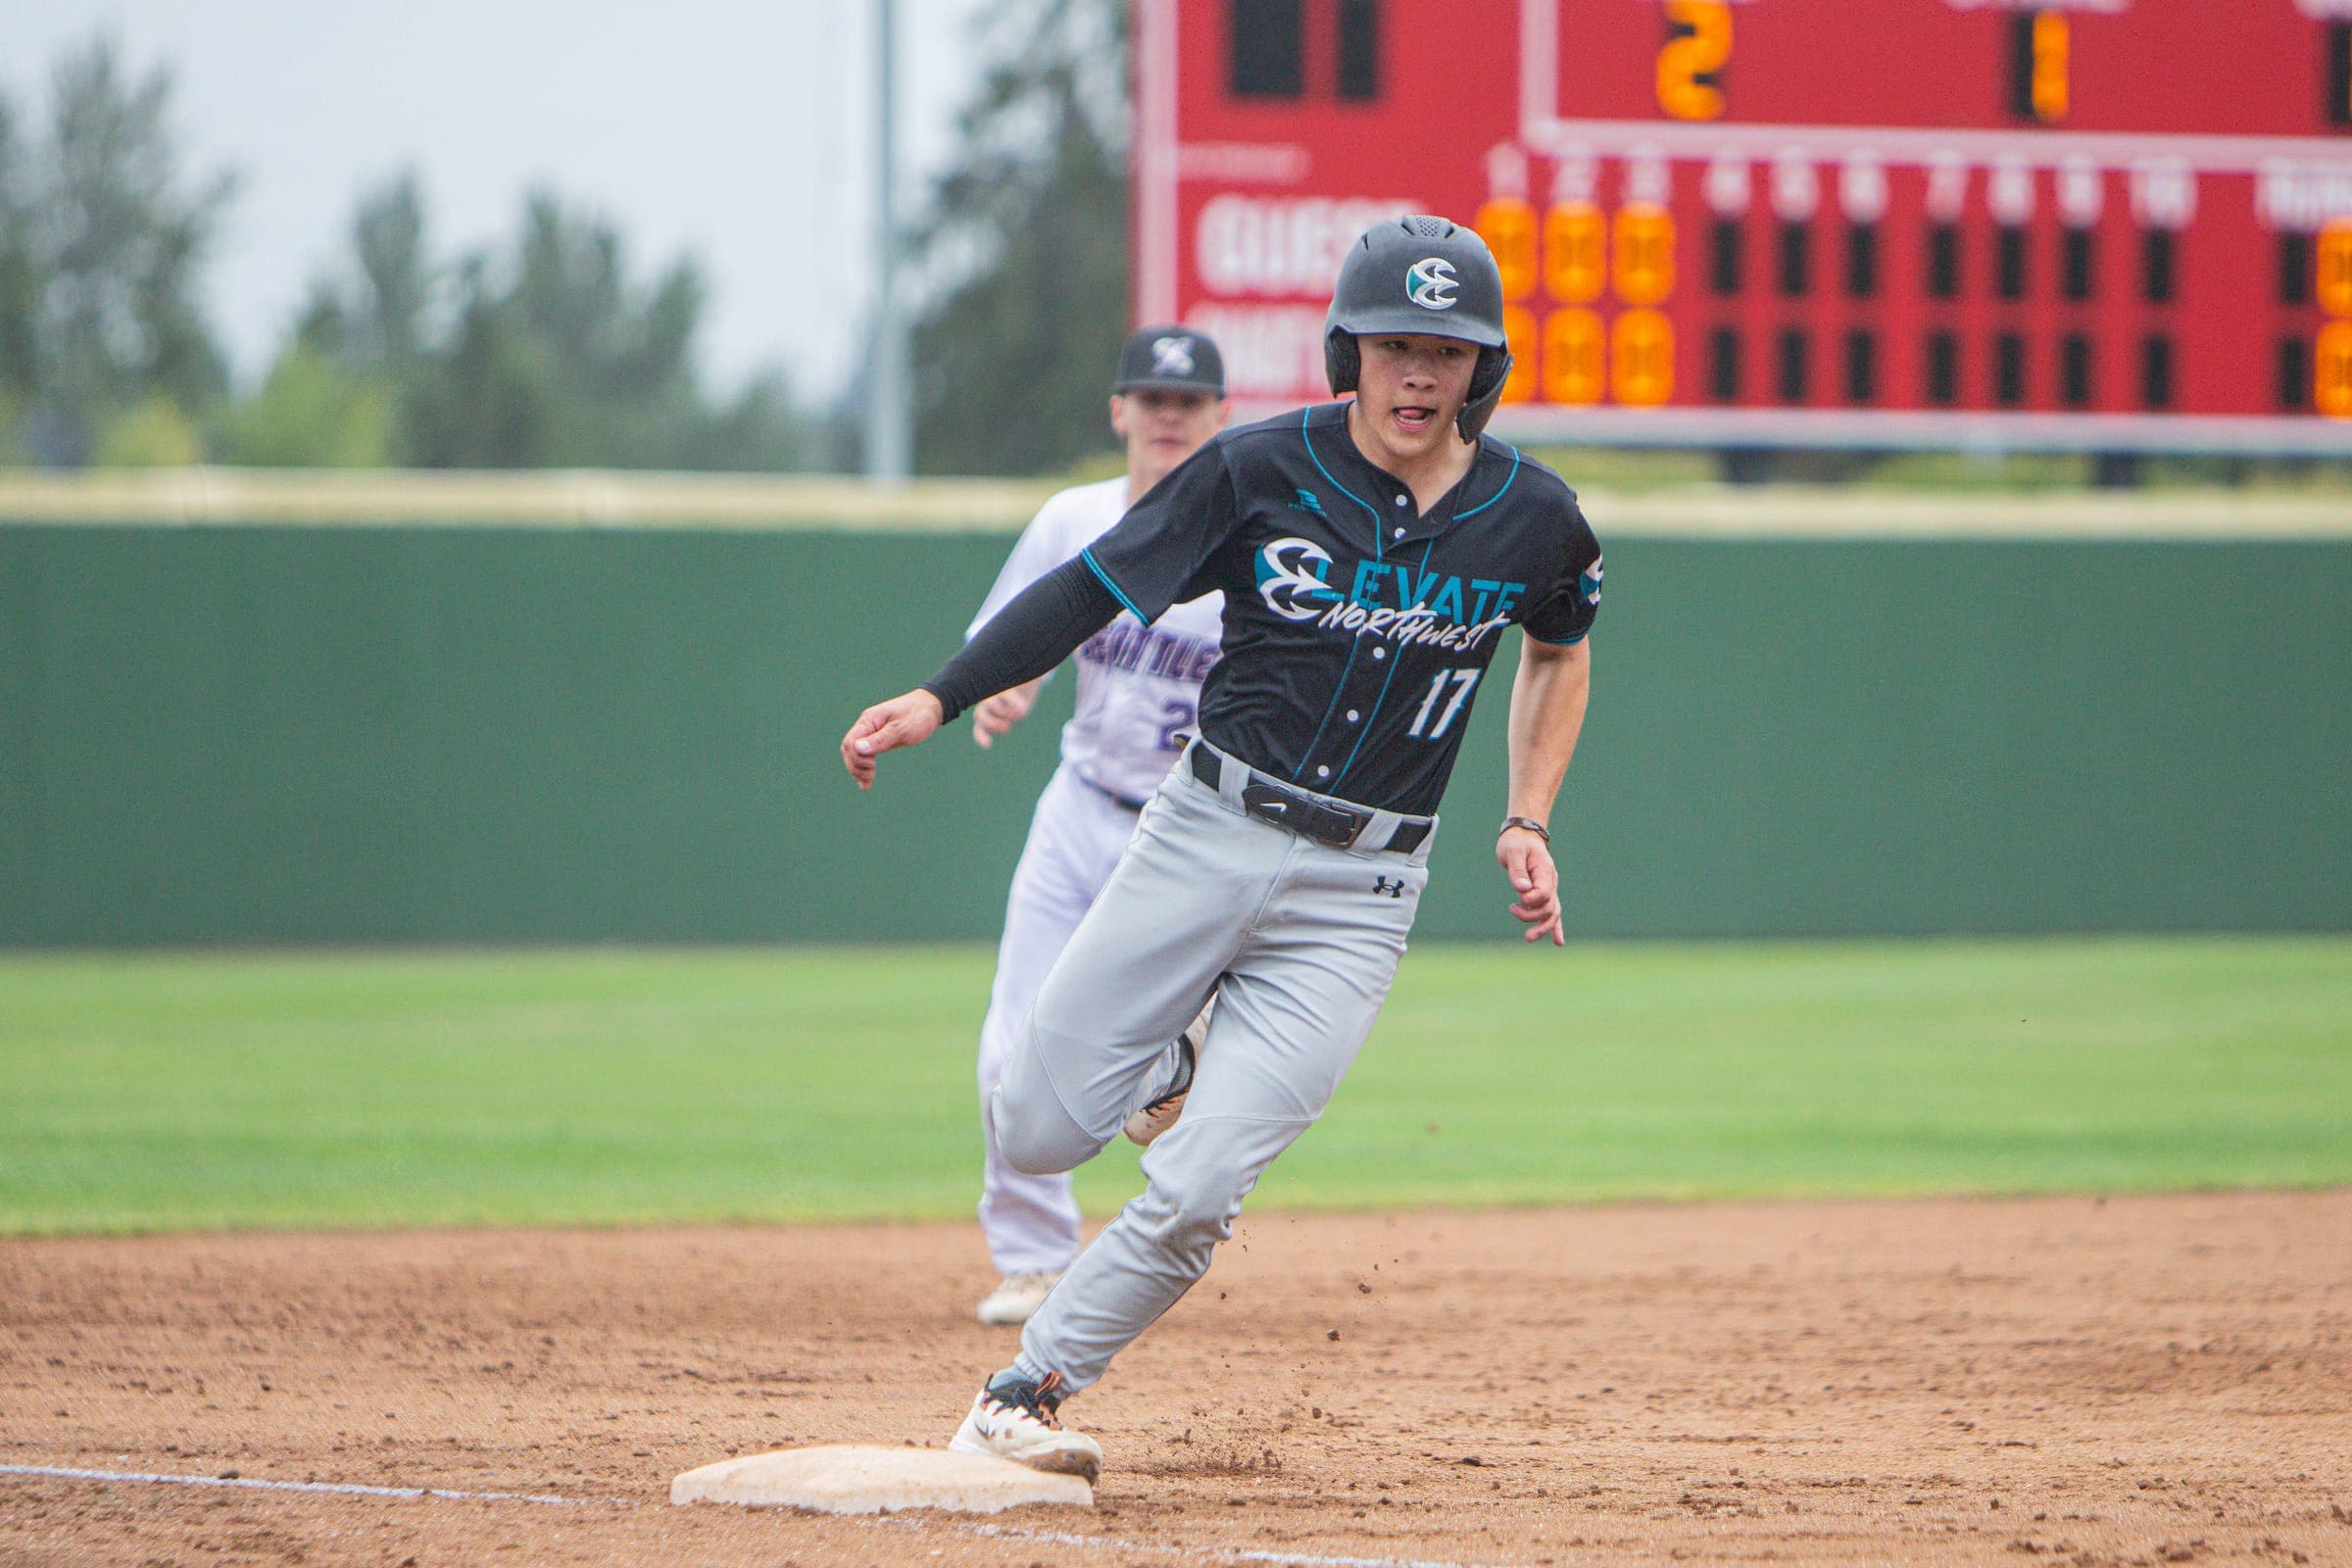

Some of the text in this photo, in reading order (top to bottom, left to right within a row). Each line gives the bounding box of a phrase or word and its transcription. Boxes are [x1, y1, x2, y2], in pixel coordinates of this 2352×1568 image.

[1657, 0, 1734, 121] 2
[1197, 195, 1426, 294] GUE
[1318, 601, 1510, 652] NORTHWEST
[1406, 666, 1483, 741] 17
